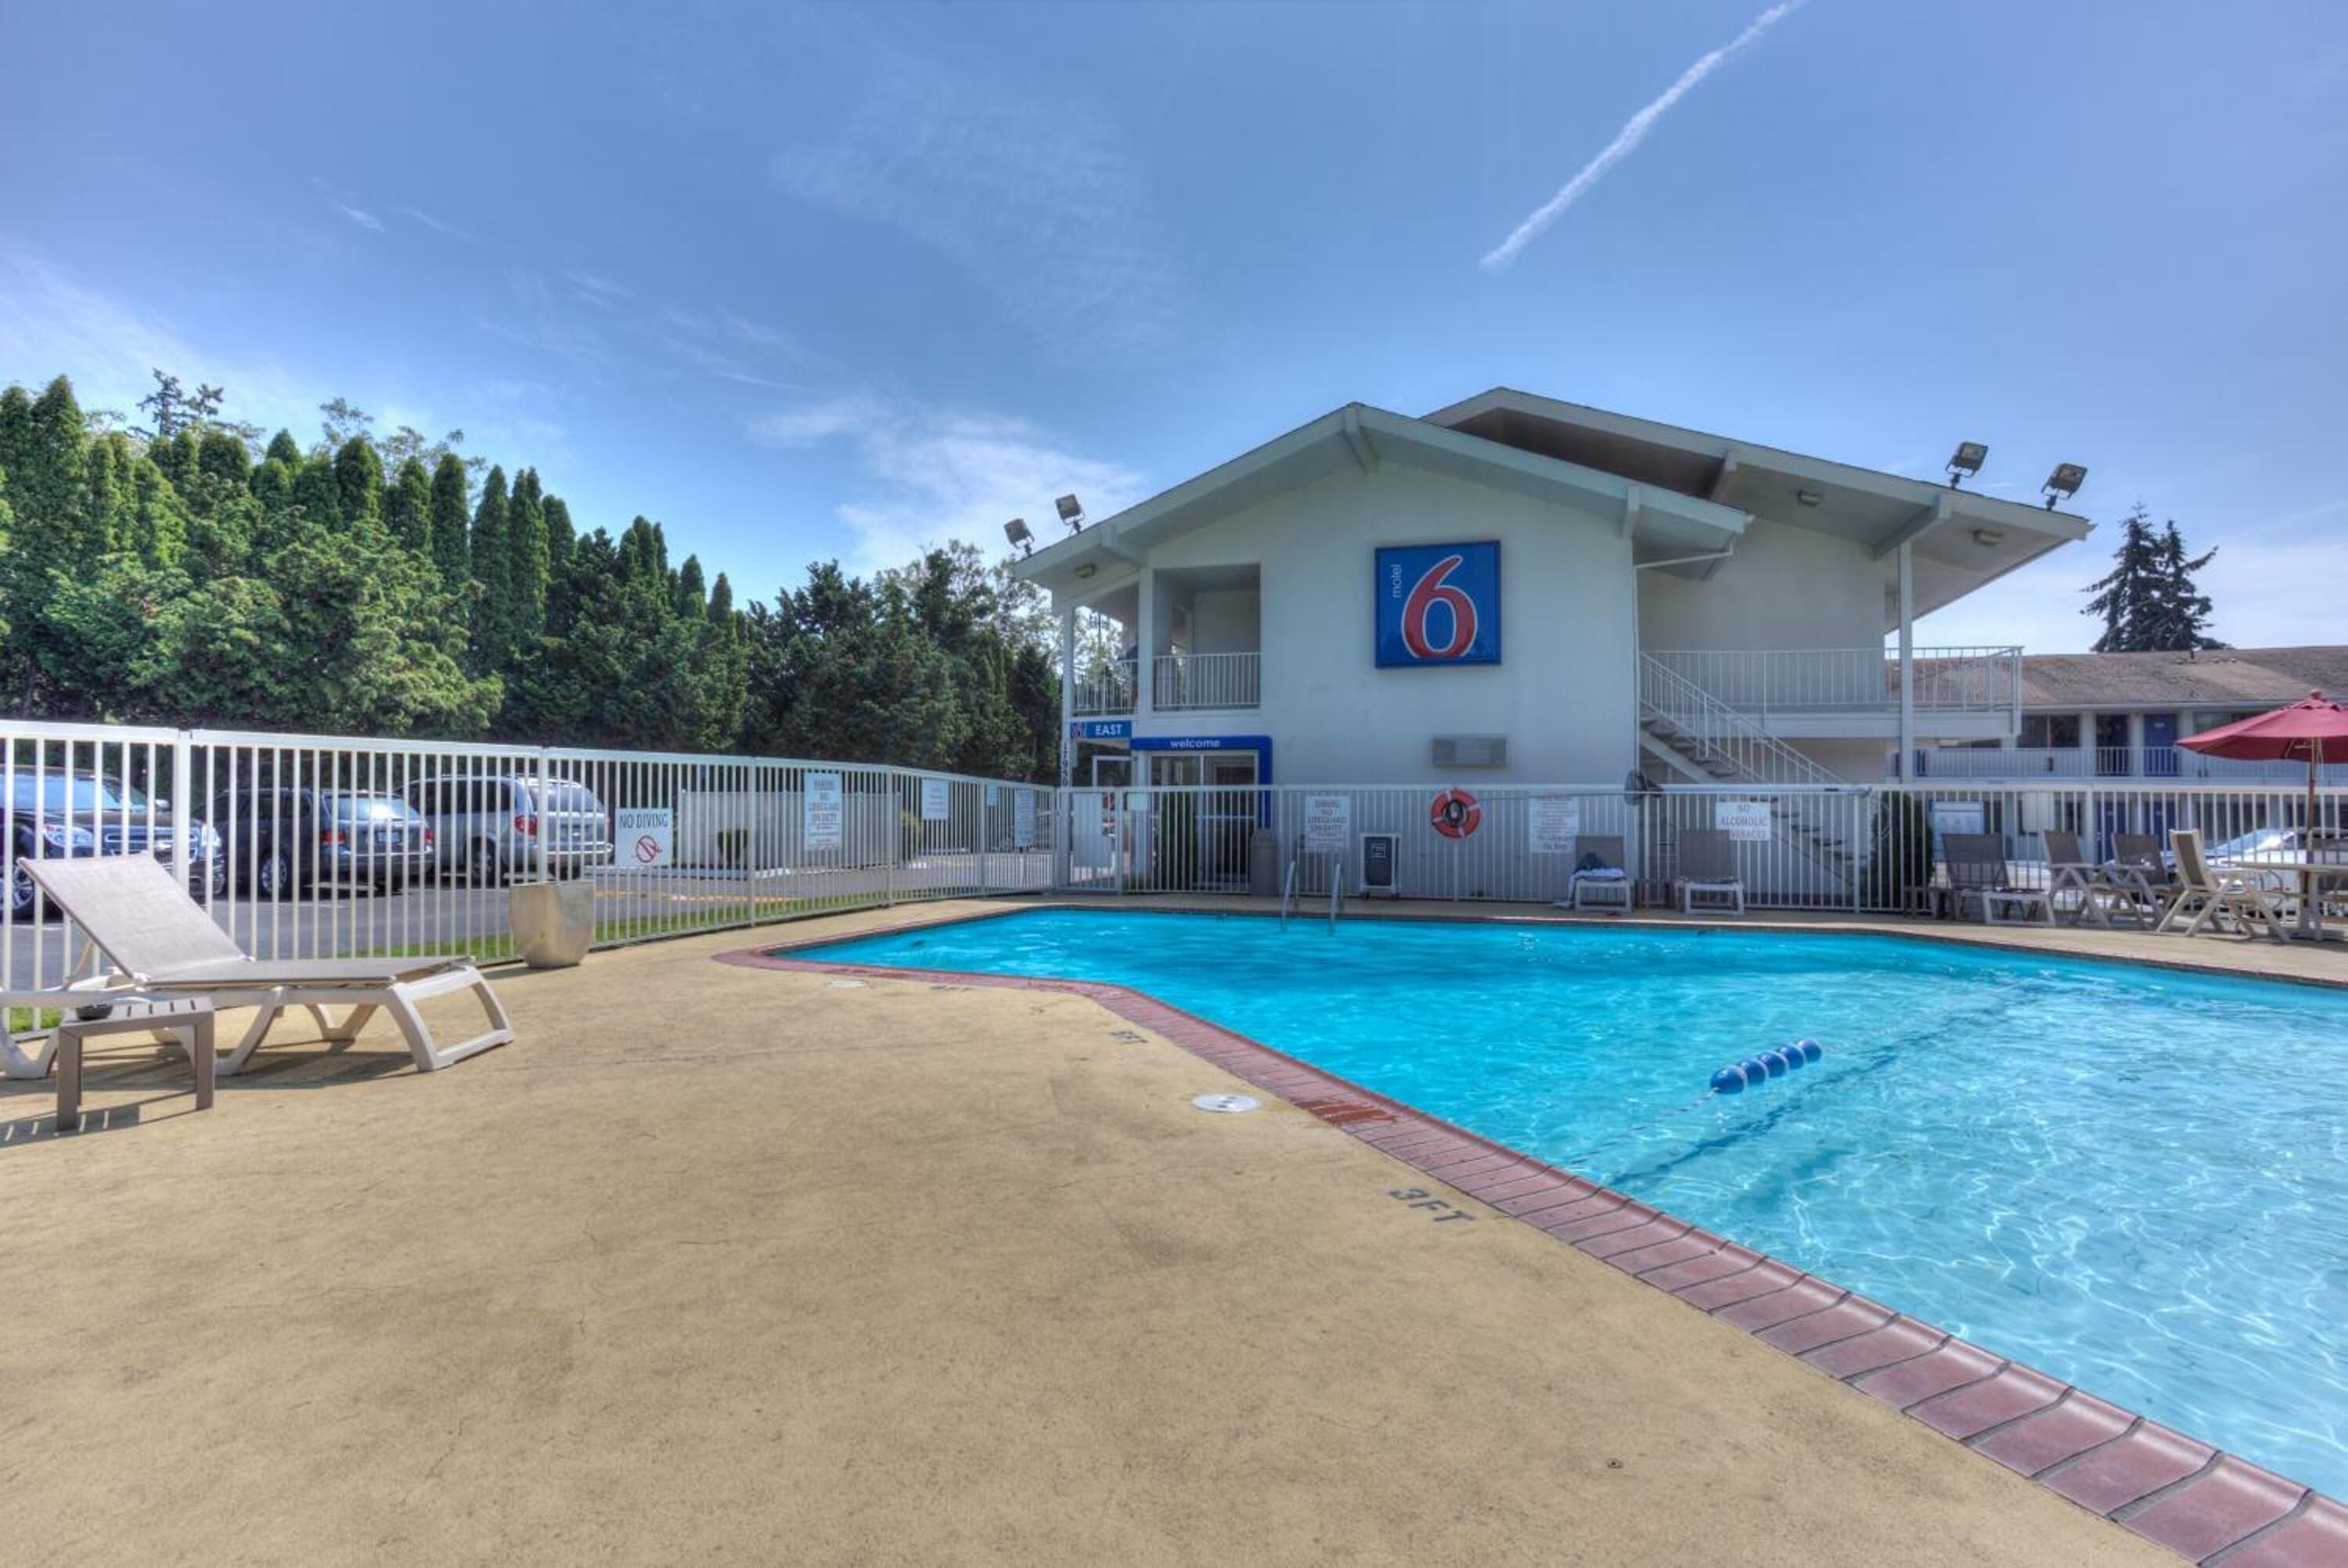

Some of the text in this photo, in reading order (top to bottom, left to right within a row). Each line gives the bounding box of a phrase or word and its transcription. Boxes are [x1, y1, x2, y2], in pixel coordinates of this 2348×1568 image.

[1390, 563, 1403, 601] motel
[1401, 553, 1478, 659] 6
[1095, 724, 1122, 736] EAST
[1170, 738, 1221, 750] welcome
[1738, 804, 1751, 814] NO
[619, 812, 669, 828] NO DIVING
[1720, 817, 1767, 826] ALCOHOLIC
[1389, 1188, 1476, 1222] 3FT
